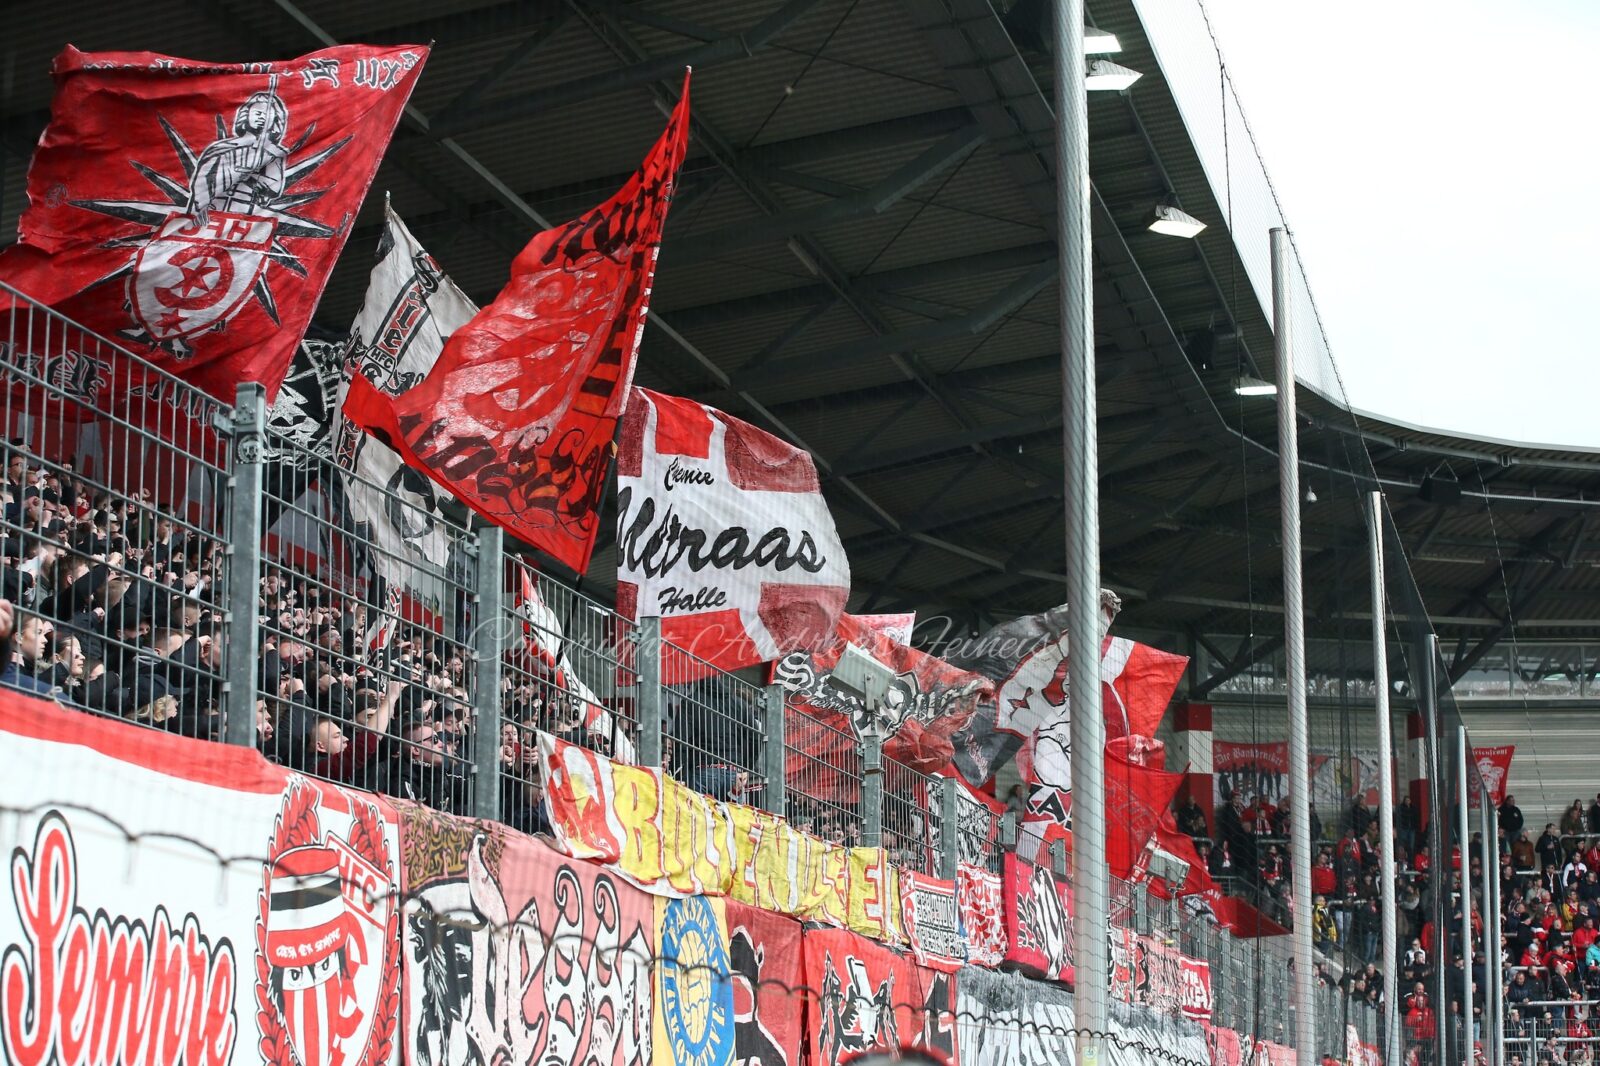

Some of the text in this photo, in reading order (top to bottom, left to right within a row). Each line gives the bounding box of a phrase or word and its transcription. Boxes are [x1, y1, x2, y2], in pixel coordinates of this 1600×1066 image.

[370, 350, 394, 369] HFC
[657, 586, 727, 615] Halle
[338, 848, 377, 914] HFC
